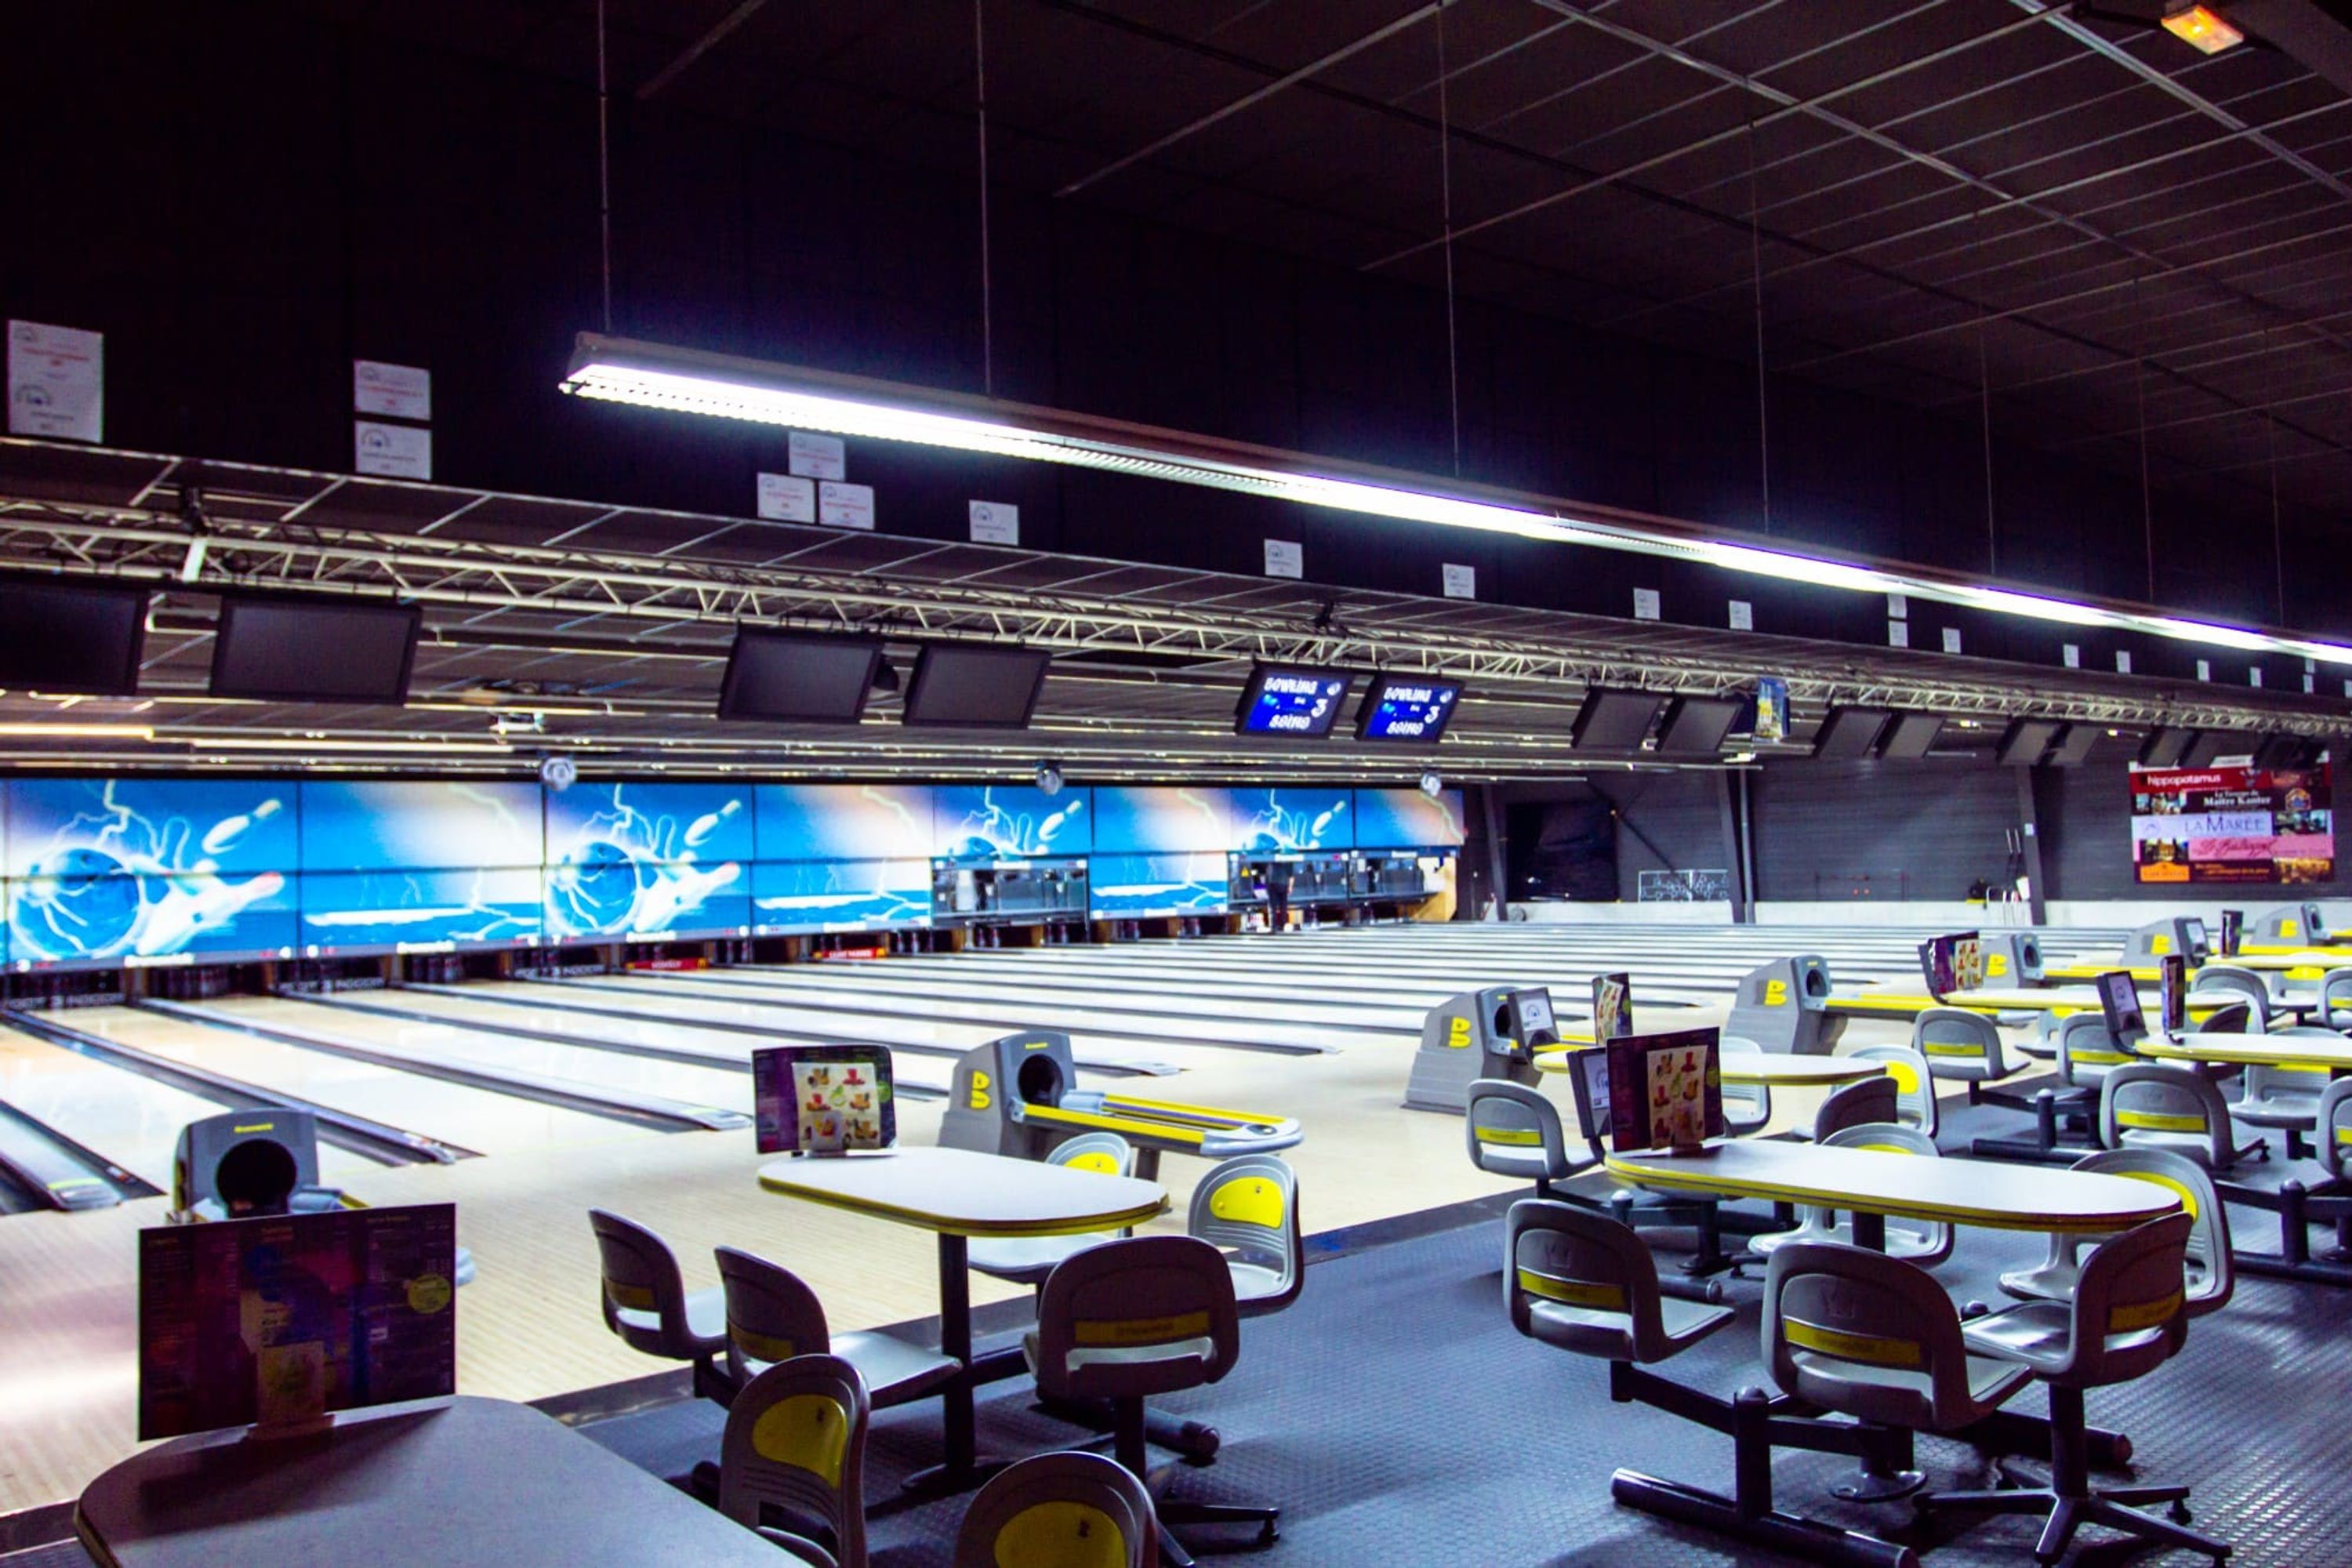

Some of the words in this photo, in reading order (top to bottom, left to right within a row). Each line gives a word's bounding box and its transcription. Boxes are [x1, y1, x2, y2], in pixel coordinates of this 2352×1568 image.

[1264, 677, 1318, 695] BOWLING
[1383, 686, 1432, 703] BOWLING
[2147, 774, 2221, 787] hippopotamus
[2237, 795, 2271, 805] Kanter
